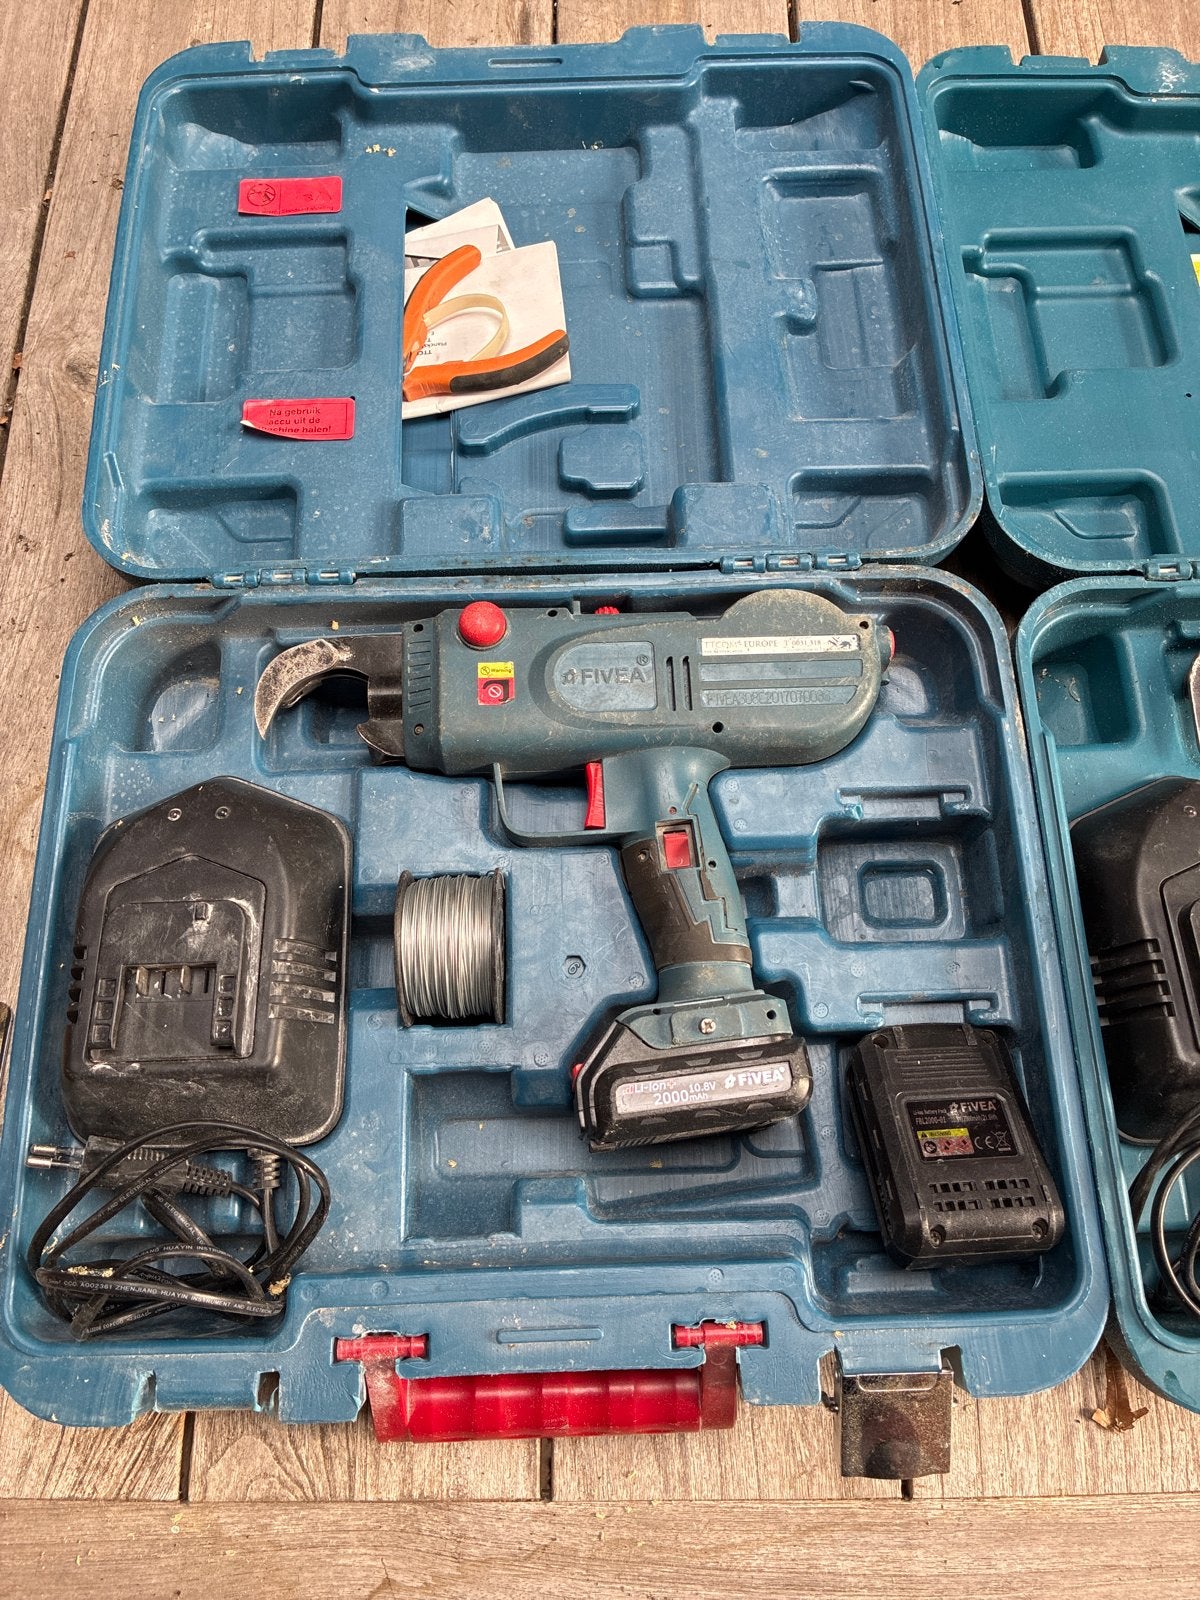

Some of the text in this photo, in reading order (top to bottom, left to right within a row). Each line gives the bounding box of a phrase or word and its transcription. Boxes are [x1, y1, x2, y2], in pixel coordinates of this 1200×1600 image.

[284, 407, 321, 416] gebruik
[744, 640, 780, 648] EUROPE
[582, 667, 646, 685] FIVEA
[688, 1082, 716, 1093] 10.8V
[654, 1090, 689, 1106] 2000
[160, 1290, 188, 1300] HUAYIN
[191, 1295, 231, 1307] INSTRUMENT
